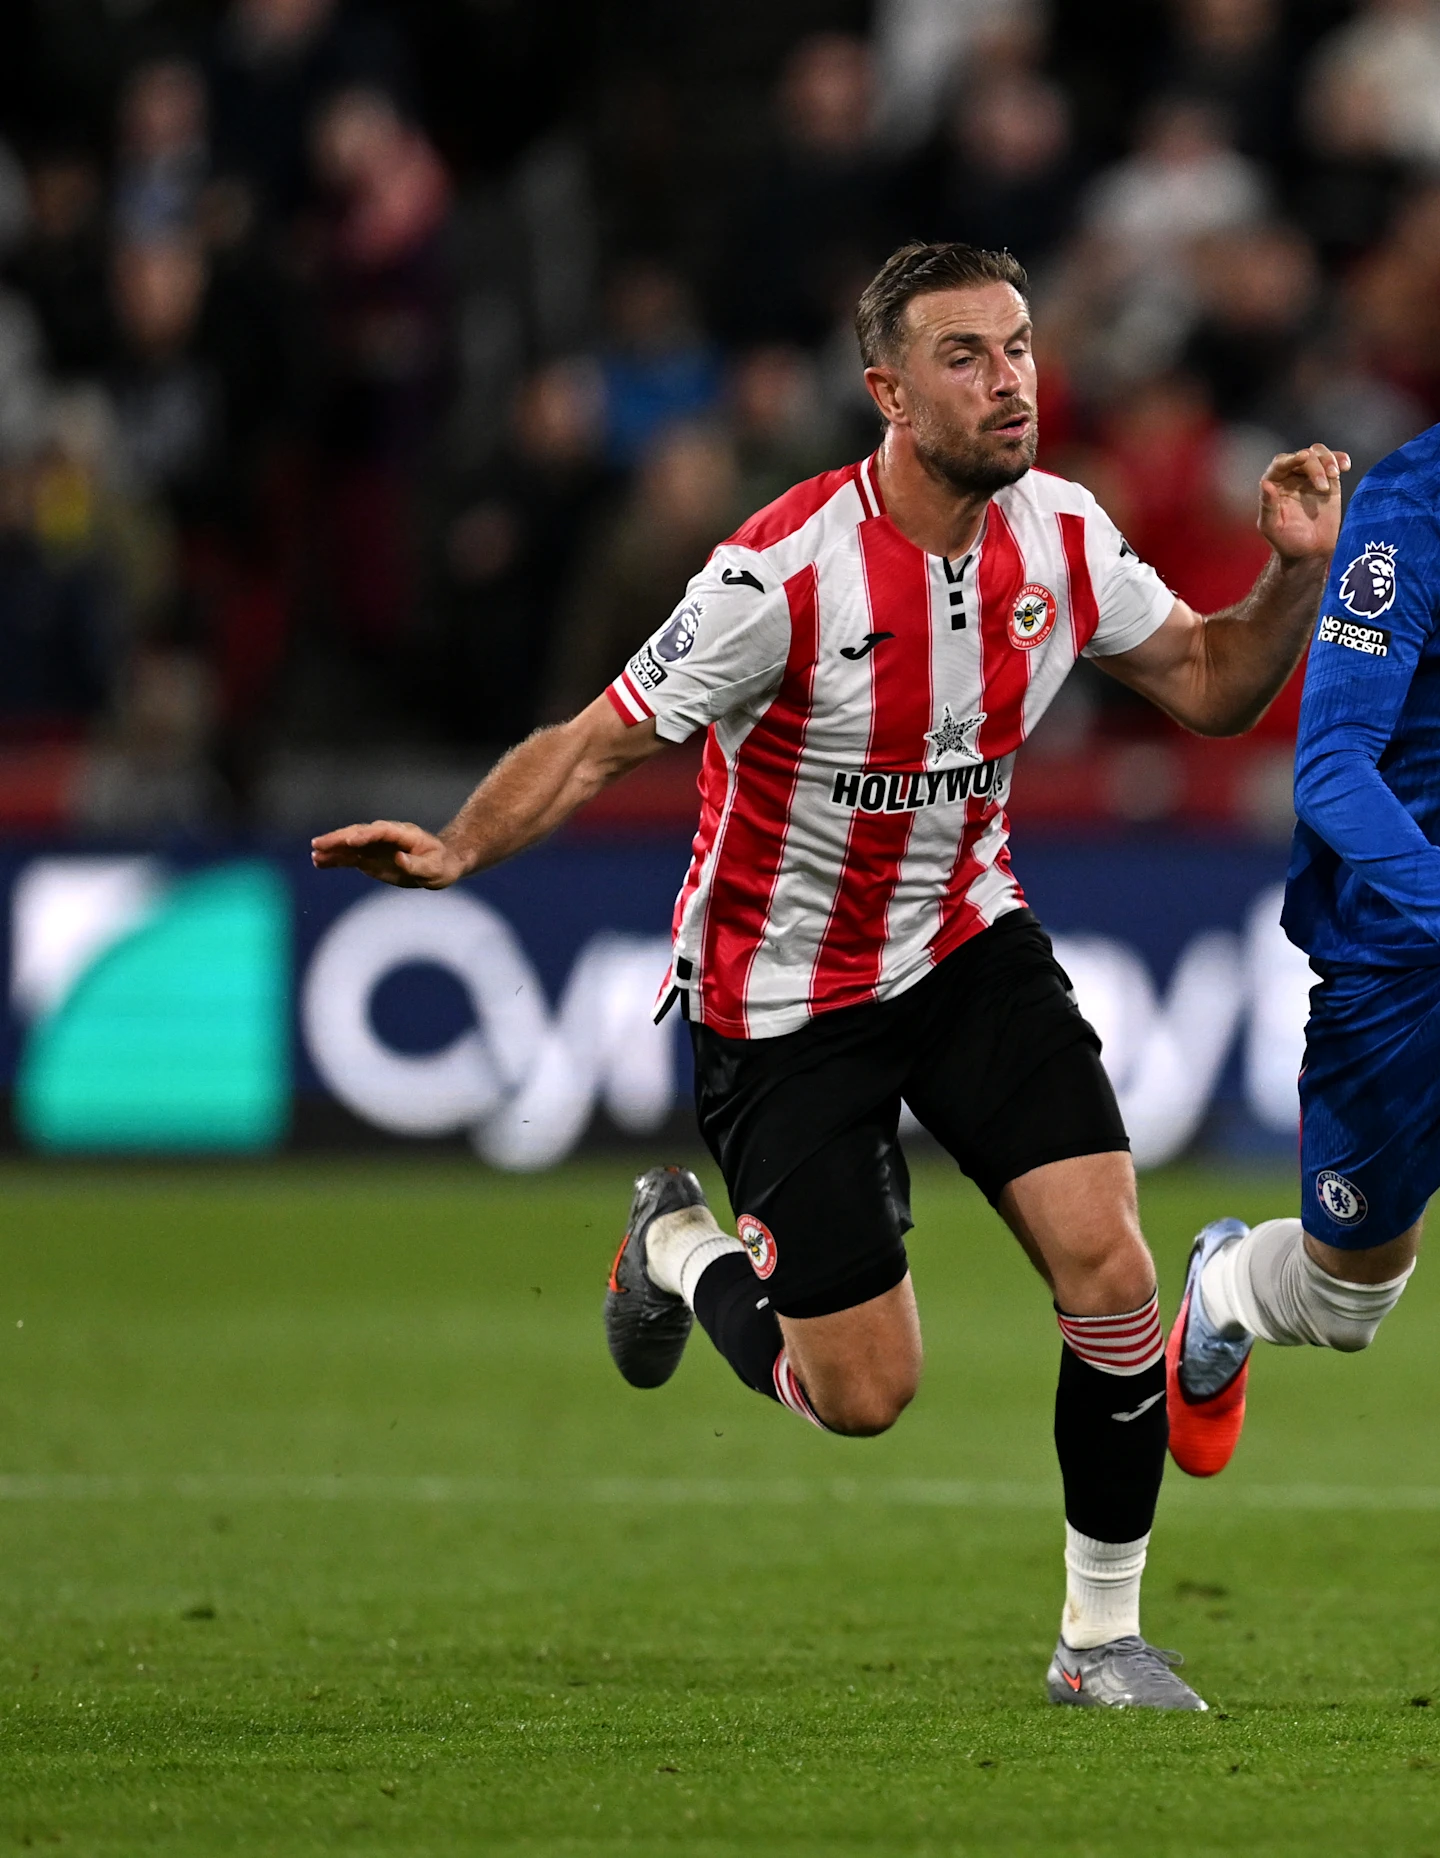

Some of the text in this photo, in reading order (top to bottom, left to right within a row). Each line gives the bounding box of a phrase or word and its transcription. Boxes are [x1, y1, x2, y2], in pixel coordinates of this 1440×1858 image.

[1318, 628, 1388, 657] for racism
[1320, 615, 1383, 643] No room
